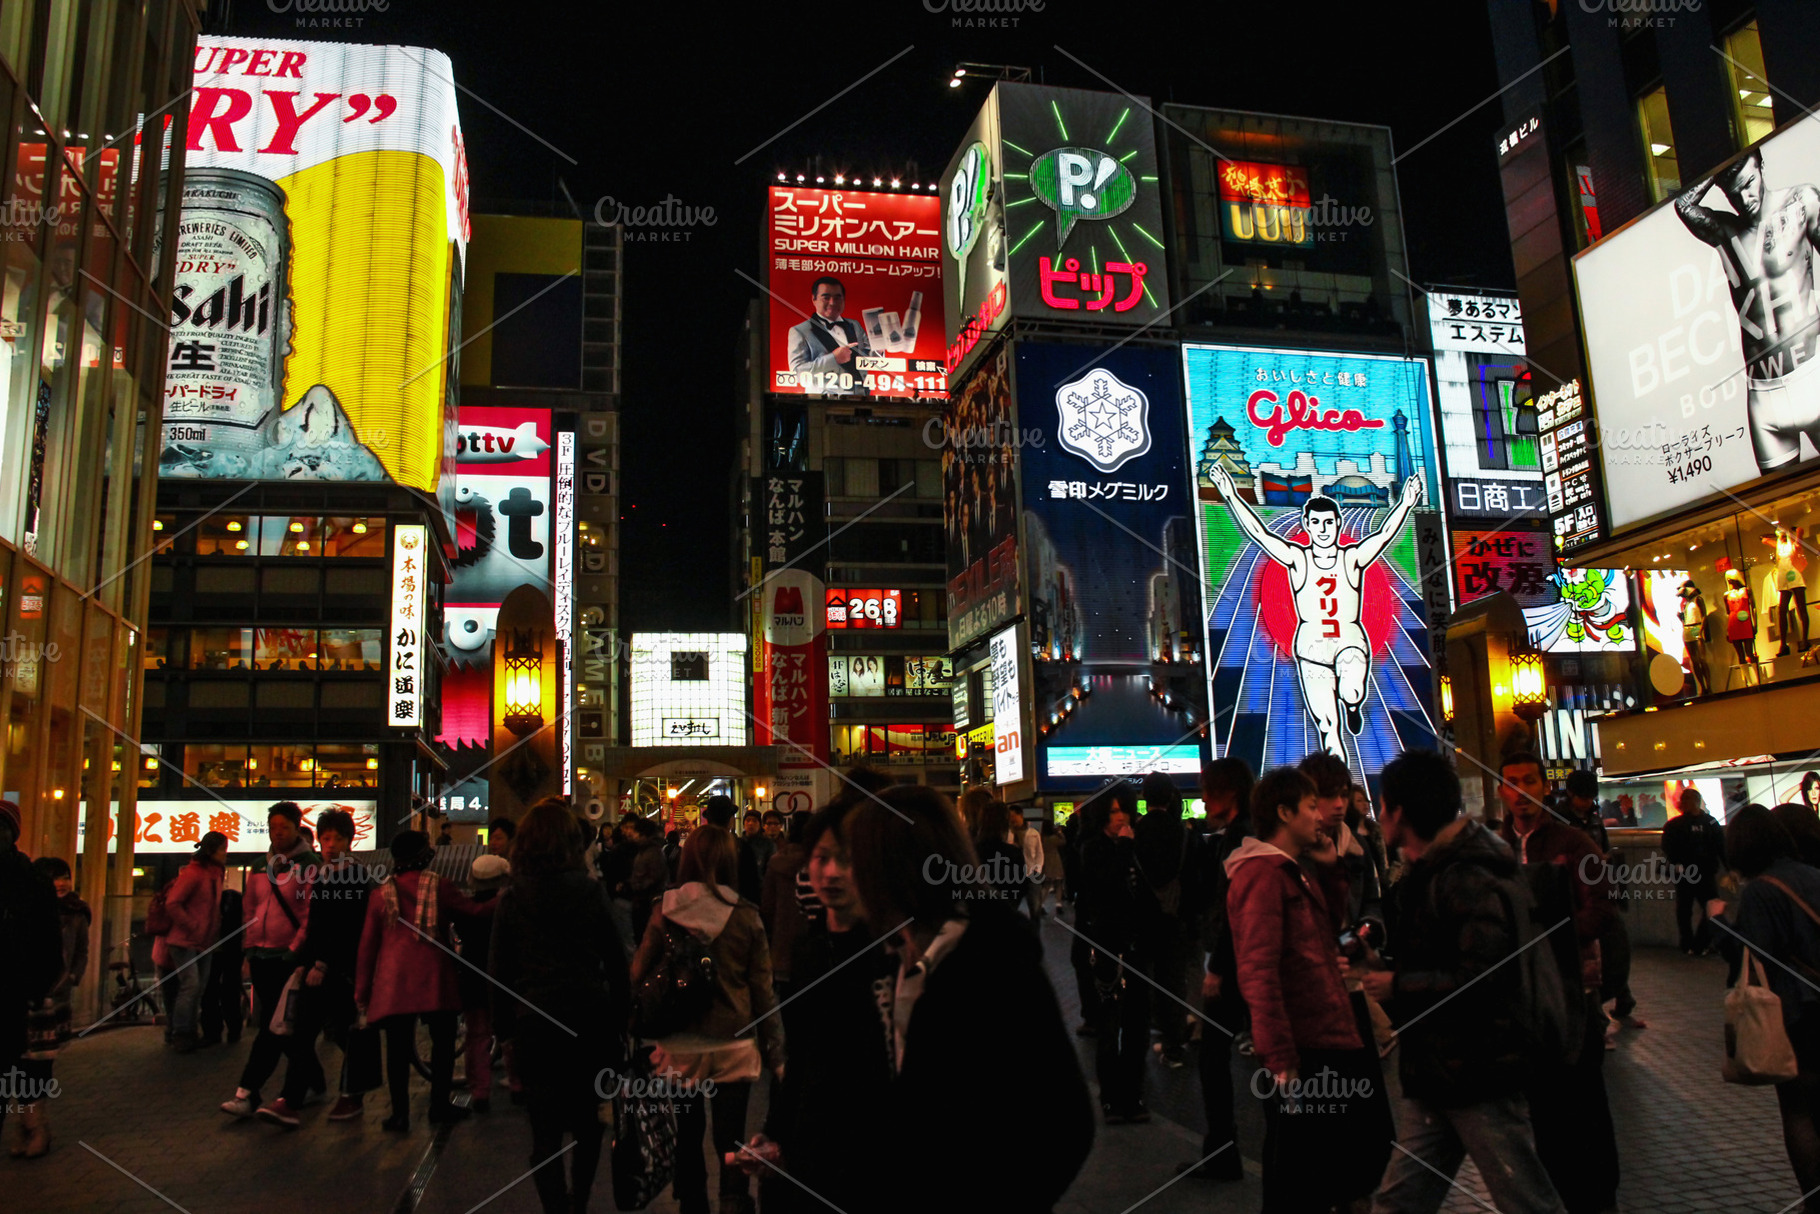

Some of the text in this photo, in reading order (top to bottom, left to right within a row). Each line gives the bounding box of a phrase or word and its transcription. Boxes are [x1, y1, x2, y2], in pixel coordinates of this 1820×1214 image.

[194, 46, 307, 78] UPER
[186, 86, 397, 155] RY”
[774, 192, 866, 215] スーパー
[774, 214, 938, 240] ミリオンヘアー
[180, 222, 257, 260] REWERIES LIMITED
[774, 238, 939, 258] SUPER MILLION HAIR
[1040, 257, 1148, 312] ピップ
[171, 274, 269, 336] sahi
[1450, 324, 1524, 344] エステム
[170, 340, 215, 370] 生
[860, 360, 889, 368] ルアン
[916, 360, 937, 372] 検索
[800, 372, 946, 392] 0120-494-111
[1256, 367, 1368, 388] おいしさと健康
[165, 385, 237, 400] ーパードライ
[1246, 390, 1385, 448] Glico
[169, 427, 206, 441] 350ml
[1662, 425, 1712, 454] ローライズ
[1667, 456, 1712, 484] ¥1,490
[1048, 480, 1169, 502] 雪印メグミルク
[788, 479, 805, 542] マルハン
[1554, 513, 1574, 536] 5F
[1466, 536, 1535, 558] かぜに
[400, 556, 417, 620] 本場の味
[1461, 562, 1546, 594] 改源
[1316, 574, 1341, 638] グリコ
[774, 616, 804, 626] マルハン
[790, 653, 808, 718] マルハン
[997, 730, 1020, 754] an
